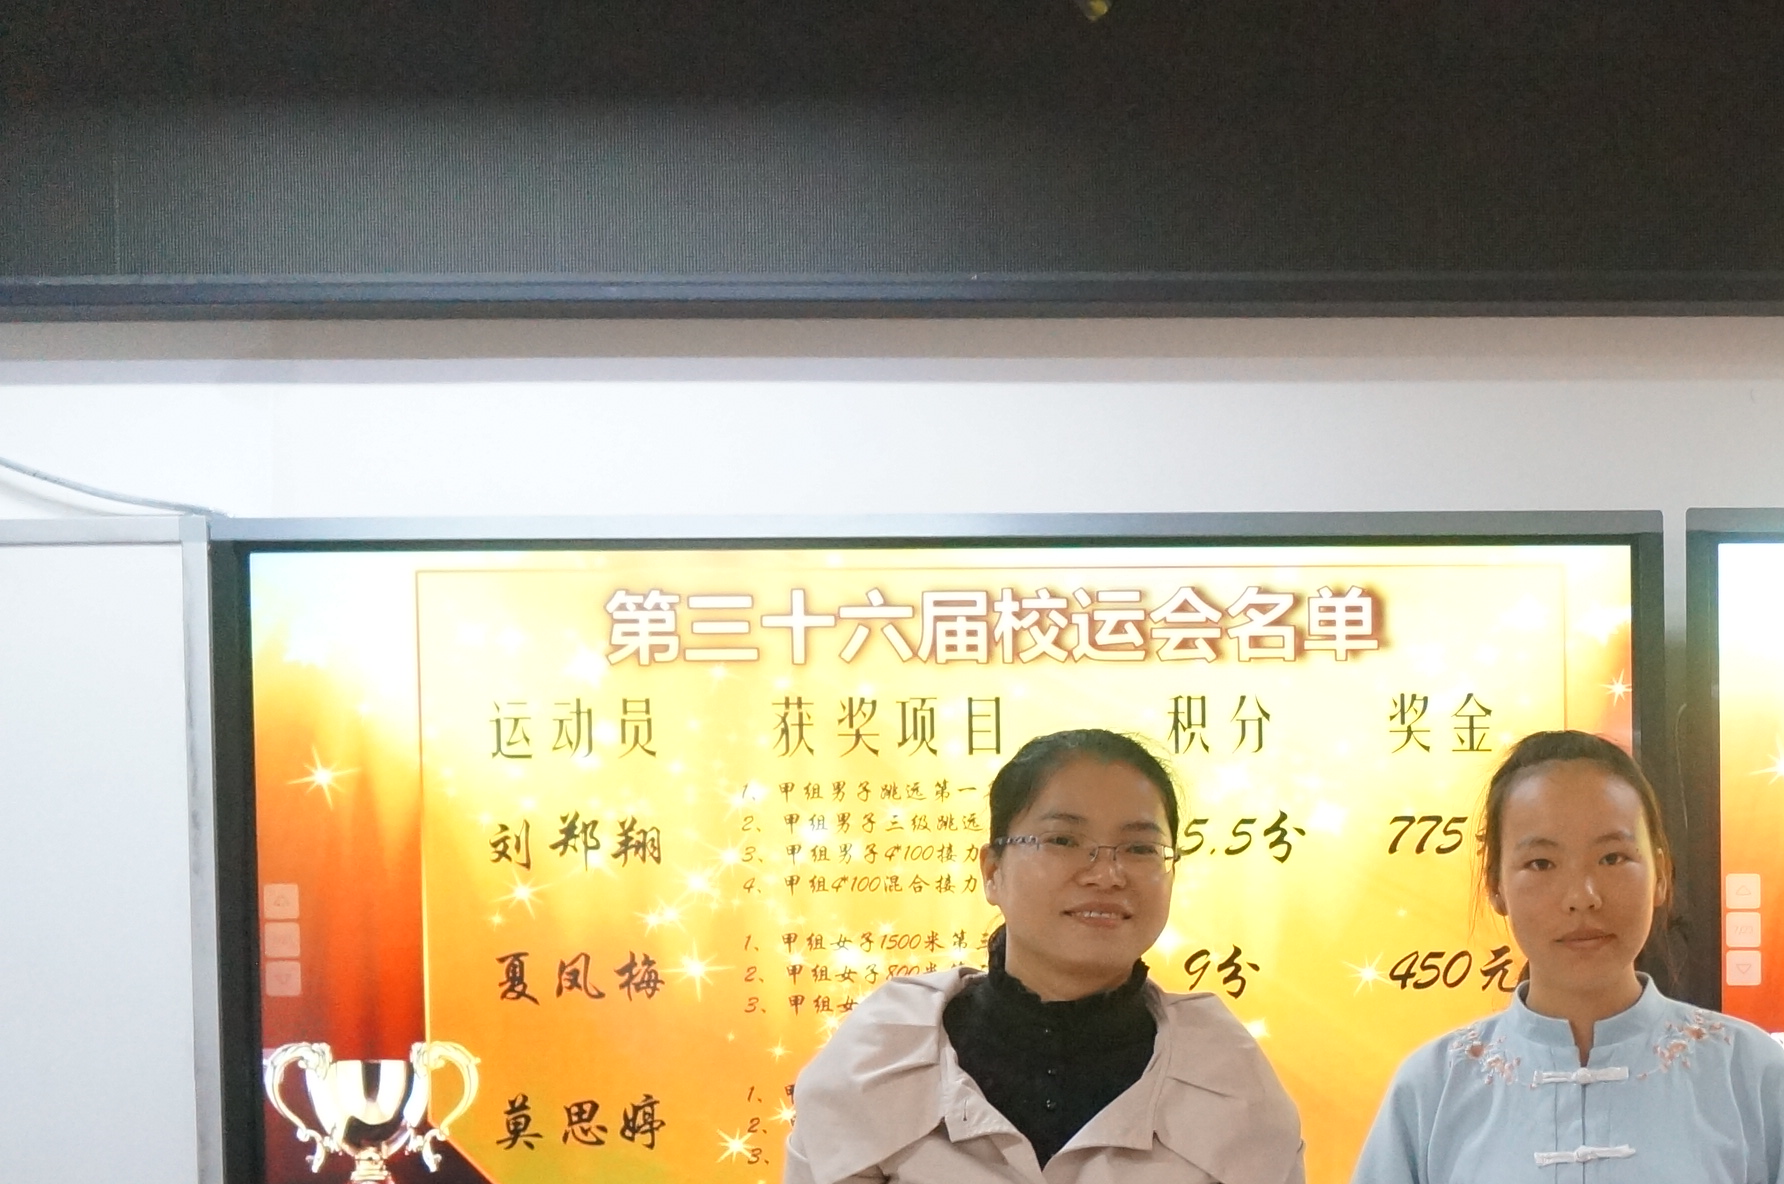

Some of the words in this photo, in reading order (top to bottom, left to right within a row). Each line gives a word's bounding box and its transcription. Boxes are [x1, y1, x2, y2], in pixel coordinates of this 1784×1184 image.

[605, 585, 1380, 668] 第三十六届校运会名单
[489, 697, 659, 760] 运动员
[772, 695, 1002, 758] 获奖项目
[1166, 693, 1272, 757] 积分
[1389, 691, 1494, 755] 奖金
[490, 808, 663, 872] 刘郑翔
[783, 811, 985, 834] 甲组男子三级跳远
[1388, 814, 1485, 856] 775
[495, 948, 666, 1006] 夏凤梅
[1184, 944, 1260, 999] 9分
[495, 1092, 667, 1151] 莫思婷
